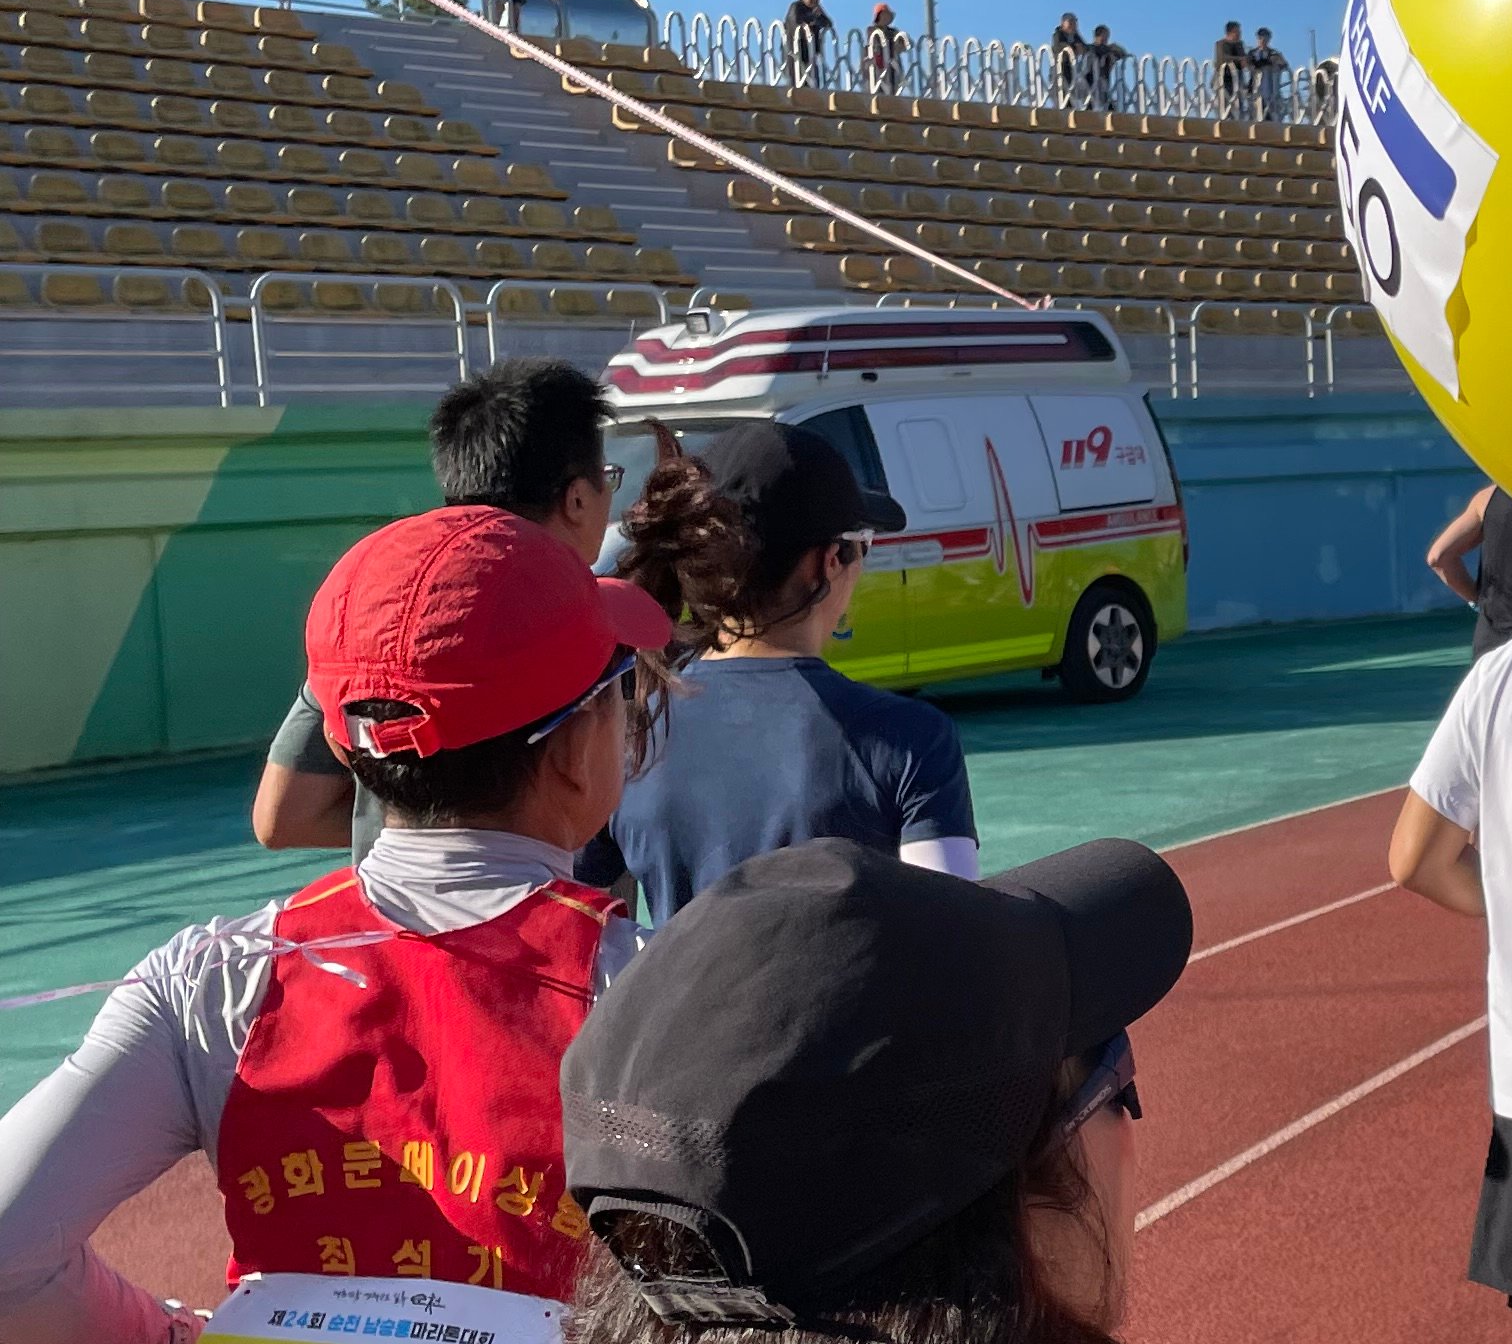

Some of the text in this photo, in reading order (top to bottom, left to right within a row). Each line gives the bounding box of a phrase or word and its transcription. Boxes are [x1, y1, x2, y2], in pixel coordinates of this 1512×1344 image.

[1350, 5, 1391, 114] HALF
[1060, 425, 1113, 470] 119
[268, 1309, 327, 1331] 제24회
